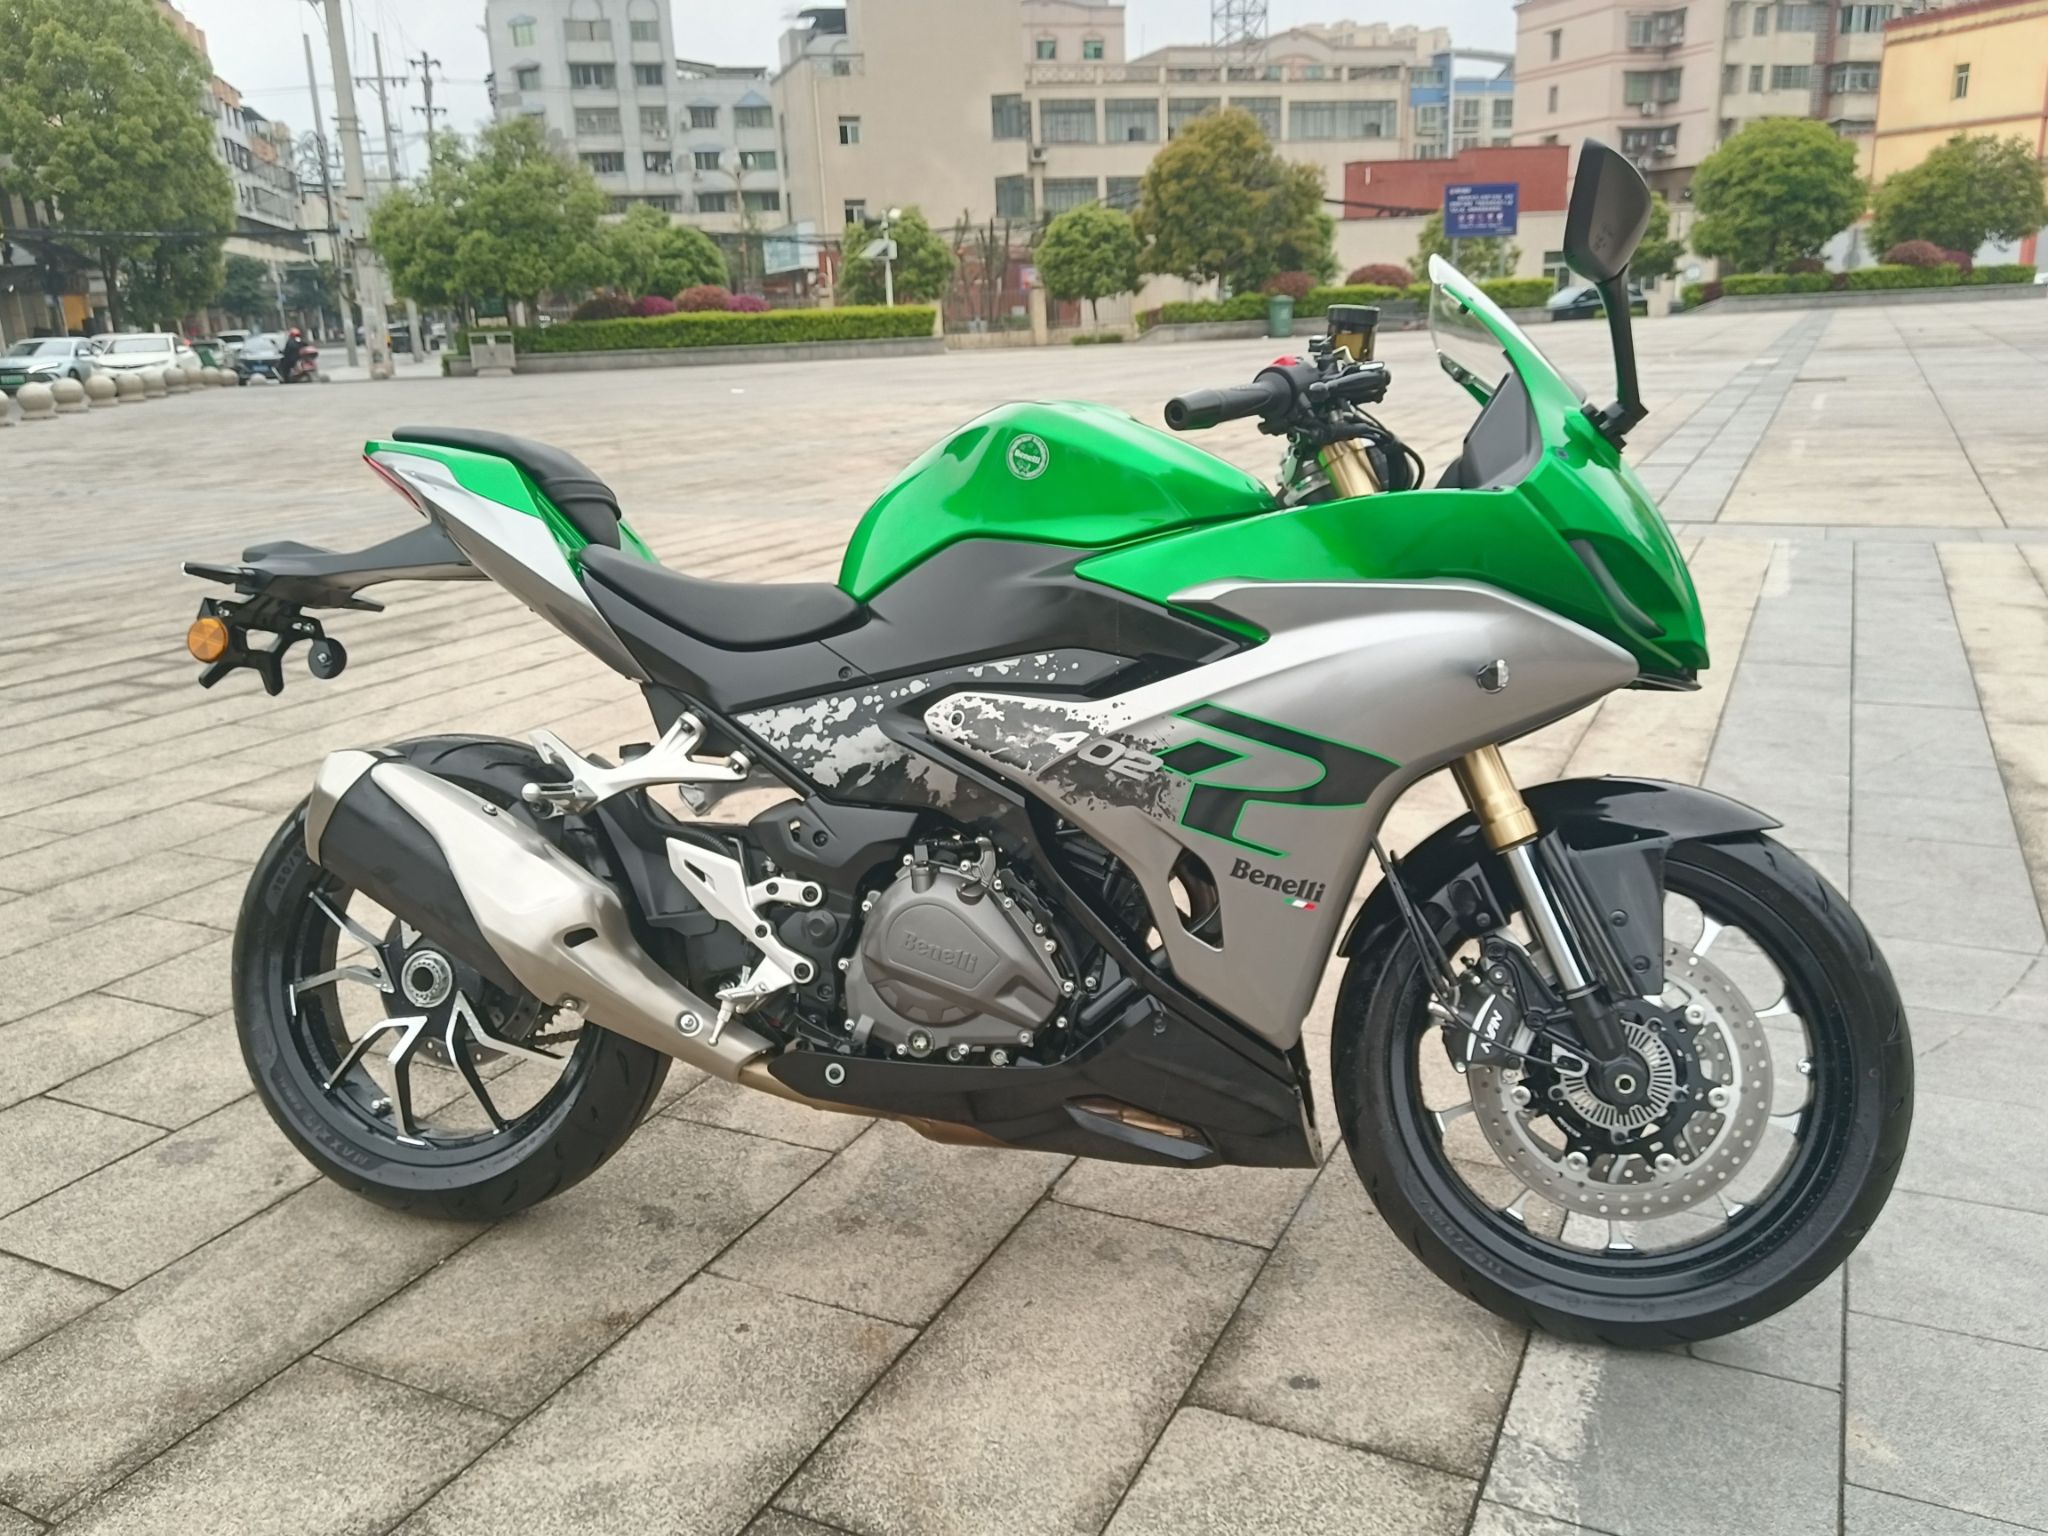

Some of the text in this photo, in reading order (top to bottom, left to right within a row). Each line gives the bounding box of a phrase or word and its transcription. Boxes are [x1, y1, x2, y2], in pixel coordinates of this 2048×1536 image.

[1045, 730, 1164, 781] 402
[1230, 857, 1326, 903] Benelli
[903, 929, 978, 974] Benelli
